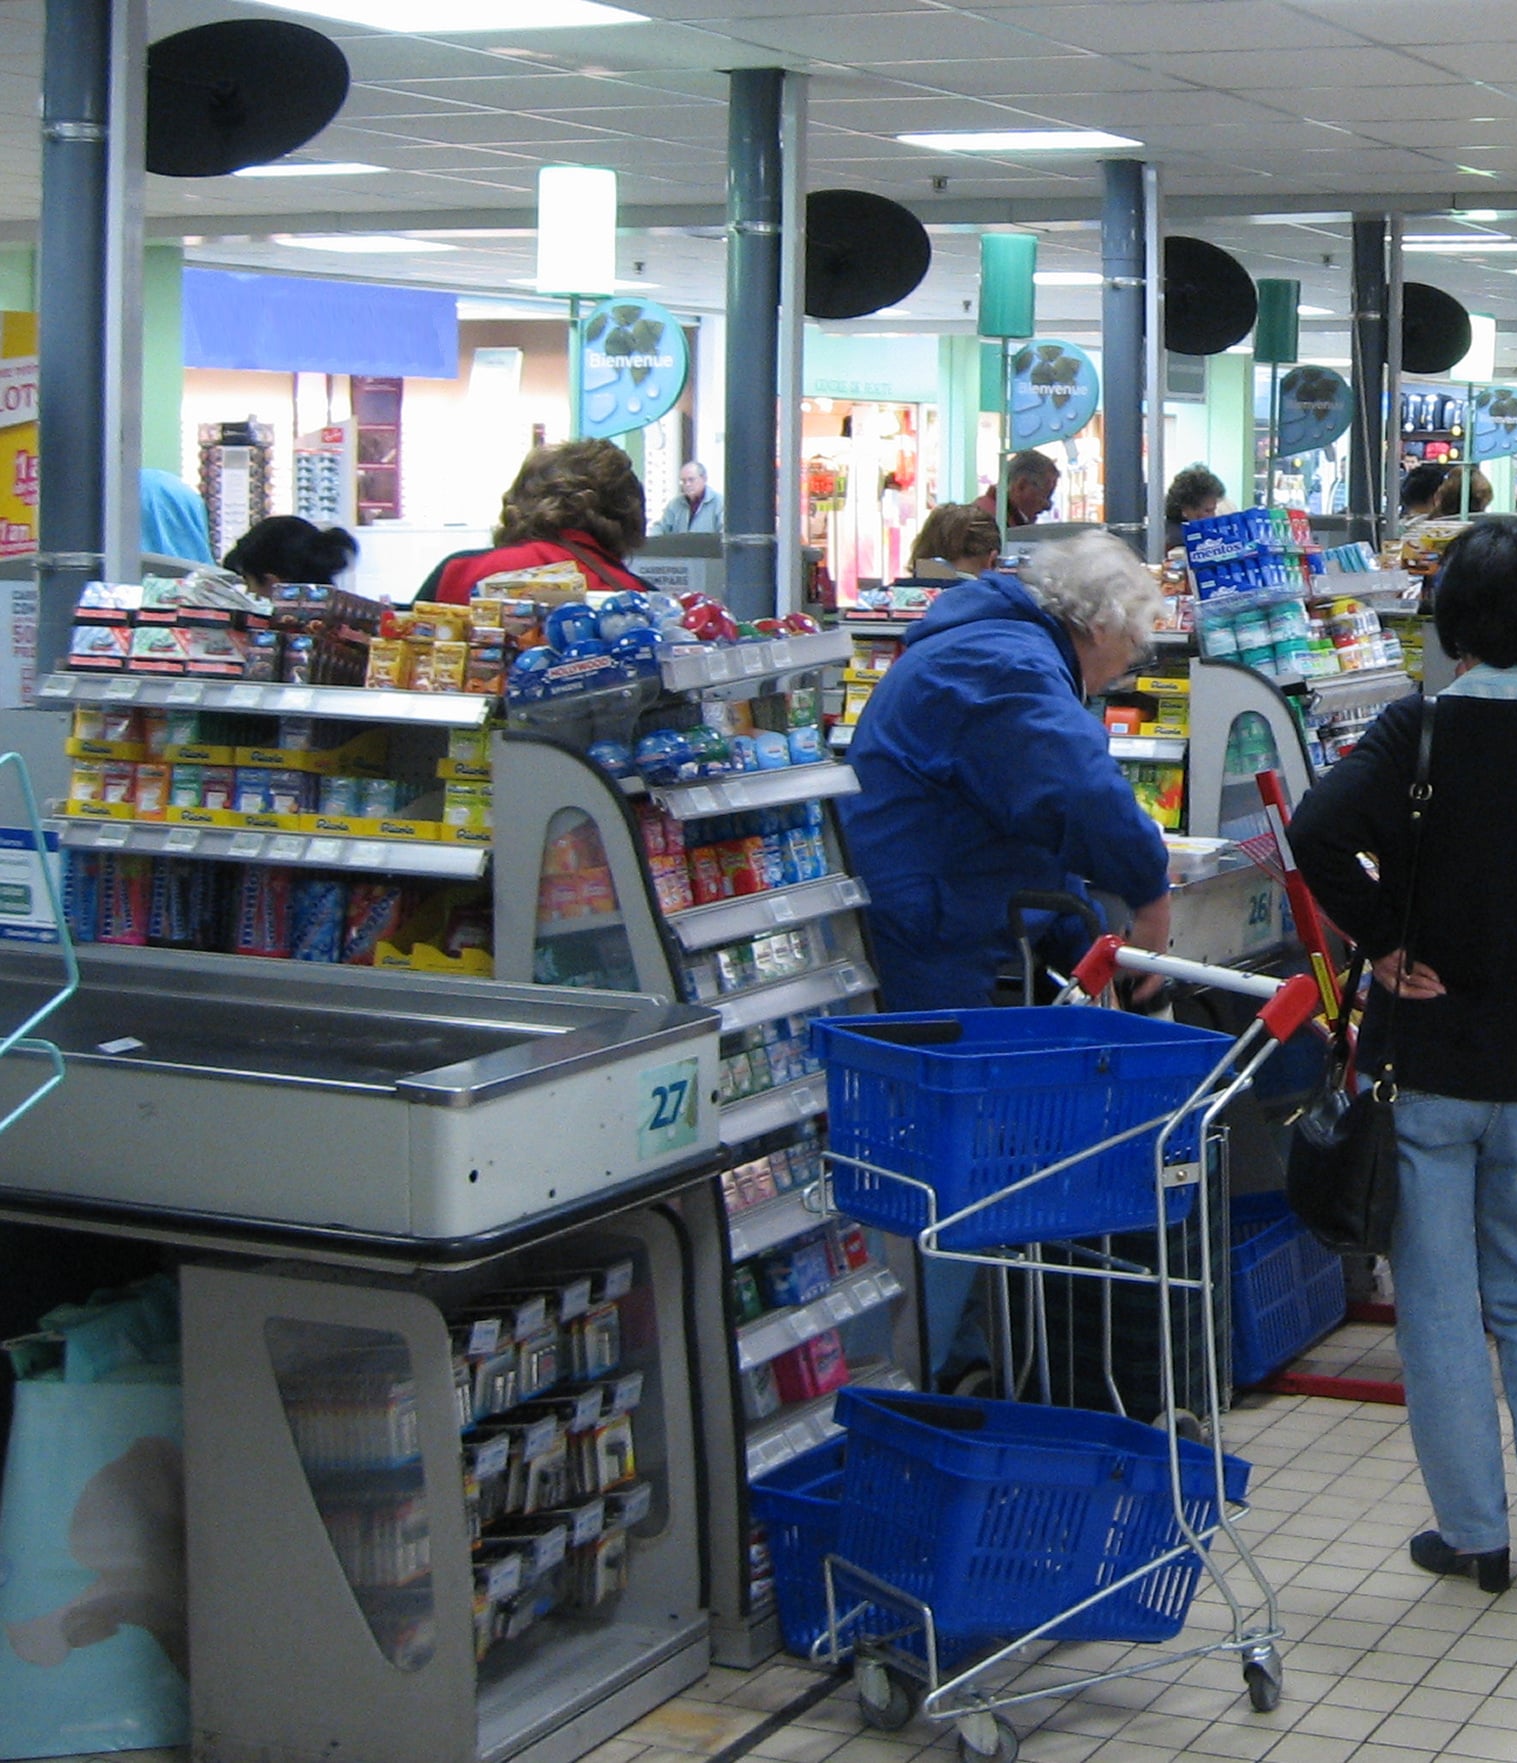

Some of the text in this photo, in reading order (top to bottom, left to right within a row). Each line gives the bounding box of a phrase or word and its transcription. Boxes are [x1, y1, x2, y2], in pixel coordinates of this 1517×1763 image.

[587, 352, 674, 369] Bienvenue
[1018, 382, 1089, 396] Bienvenue
[1192, 543, 1242, 560] mentos
[550, 657, 611, 677] HOLLYWOOD
[1248, 892, 1269, 926] 26
[648, 1079, 689, 1131] 27
